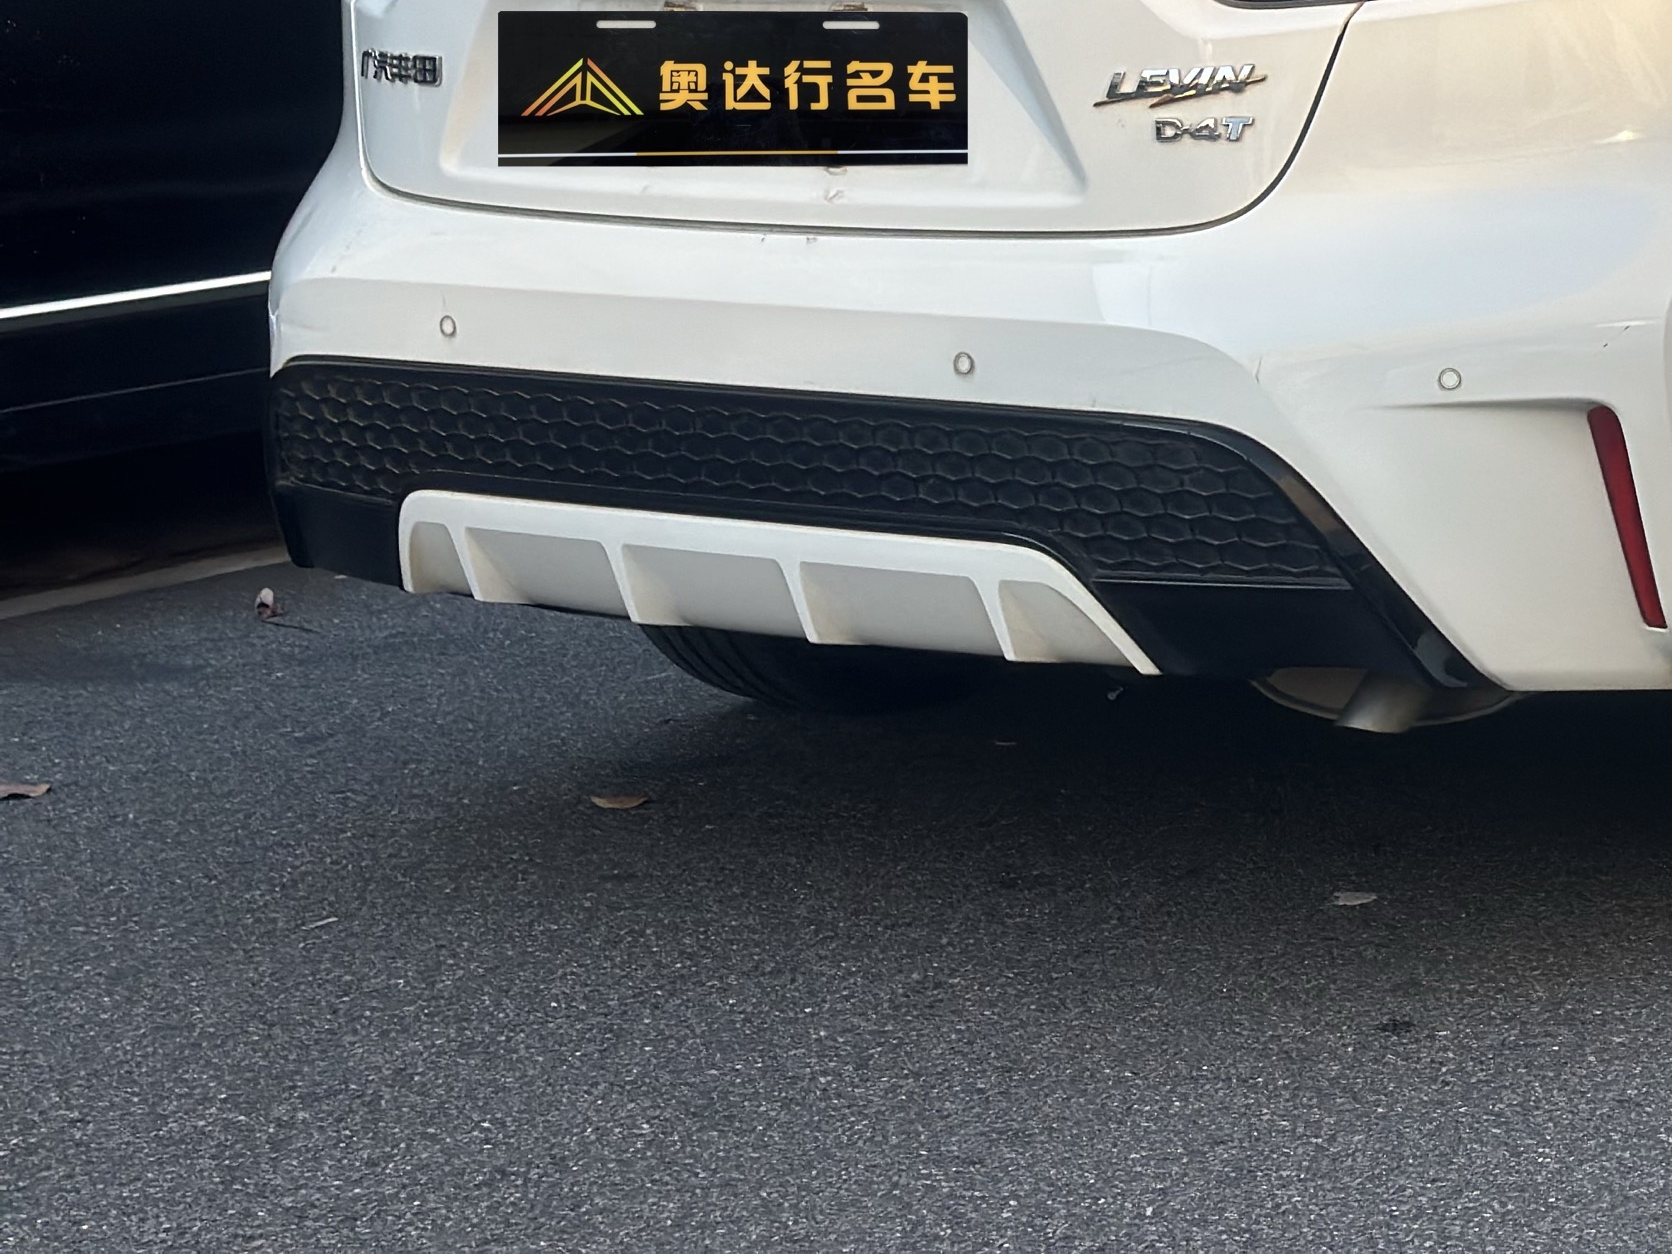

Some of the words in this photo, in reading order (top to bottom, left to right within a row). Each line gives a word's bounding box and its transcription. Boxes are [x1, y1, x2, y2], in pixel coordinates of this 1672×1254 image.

[361, 48, 443, 88] 广汽丰田
[659, 59, 958, 112] 奥达行名车
[1104, 63, 1259, 101] LEVIN
[1153, 115, 1256, 144] D-4T
